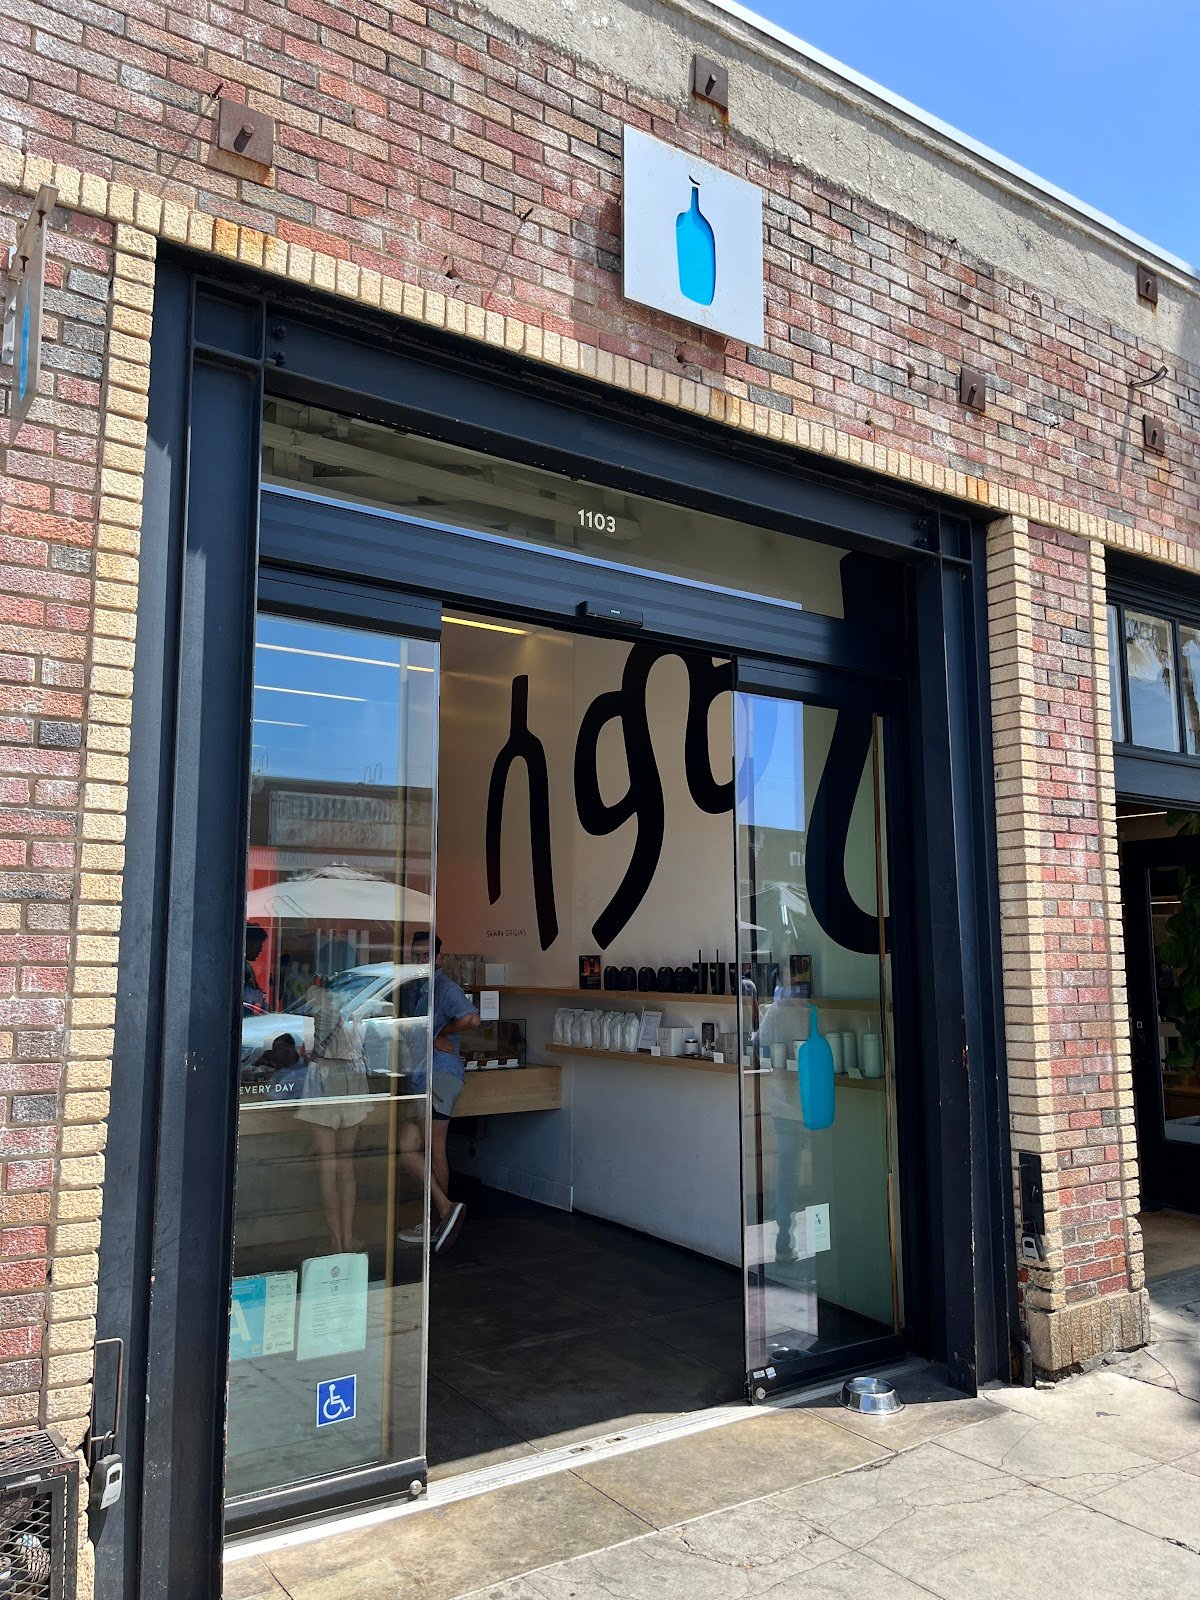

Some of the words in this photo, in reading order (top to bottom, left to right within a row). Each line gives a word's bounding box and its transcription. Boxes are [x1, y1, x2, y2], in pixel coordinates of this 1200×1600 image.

[577, 509, 616, 533] 1103
[239, 1084, 271, 1095] EVERY
[275, 1082, 295, 1092] DAY
[230, 1299, 252, 1342] A
